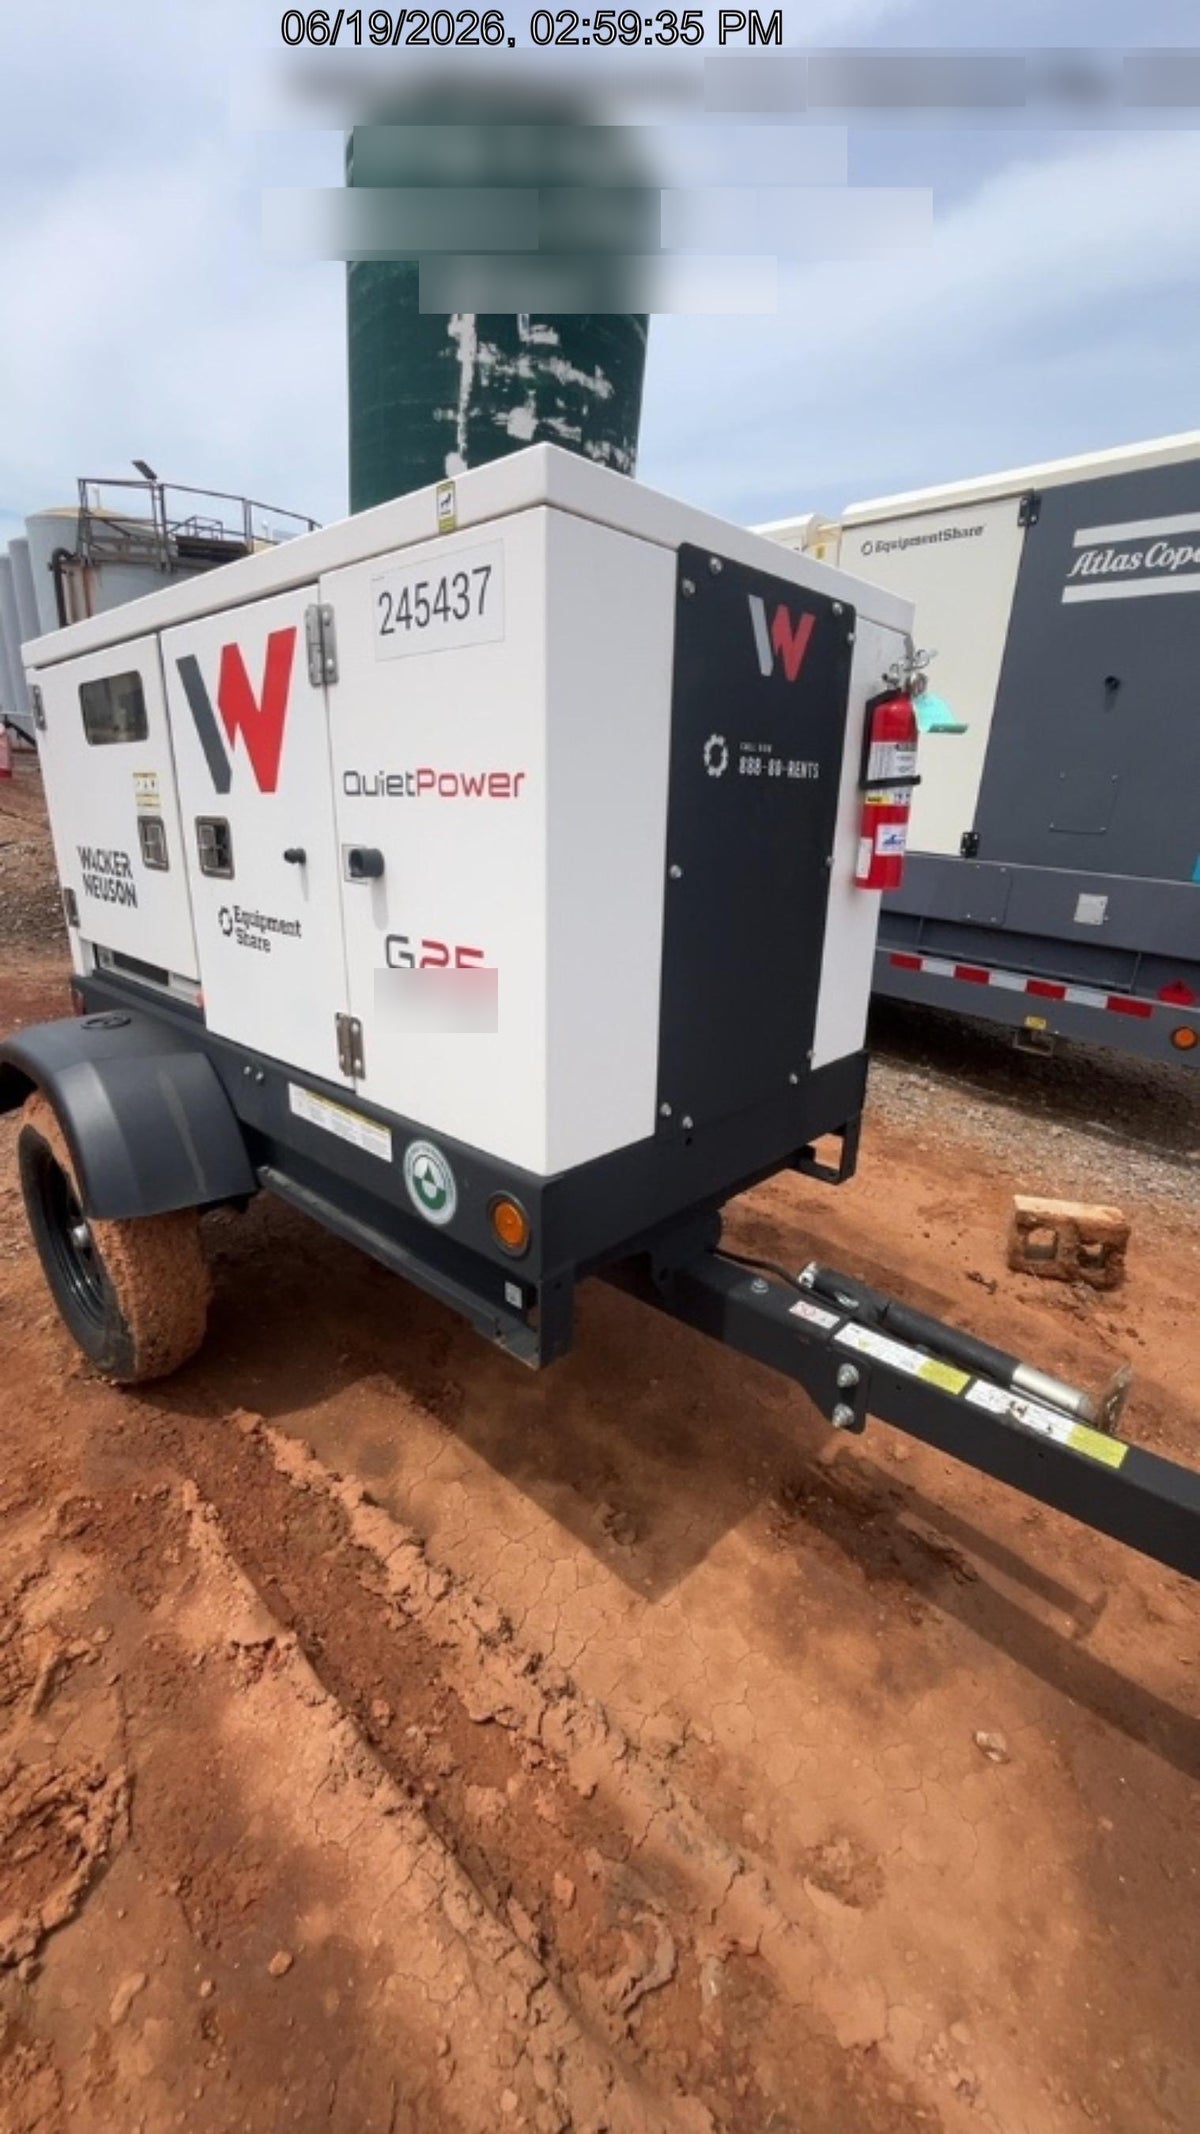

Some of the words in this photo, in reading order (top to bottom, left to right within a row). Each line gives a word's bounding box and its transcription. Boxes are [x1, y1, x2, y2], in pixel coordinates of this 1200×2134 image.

[875, 524, 985, 553] EquipmentShare
[1066, 548, 1144, 578] Atlas
[378, 564, 492, 636] 245437
[343, 767, 526, 798] QuietPower
[76, 846, 134, 880] WACKER
[82, 872, 139, 909] NEUSON
[232, 904, 303, 938] Equipment
[235, 926, 271, 953] Share
